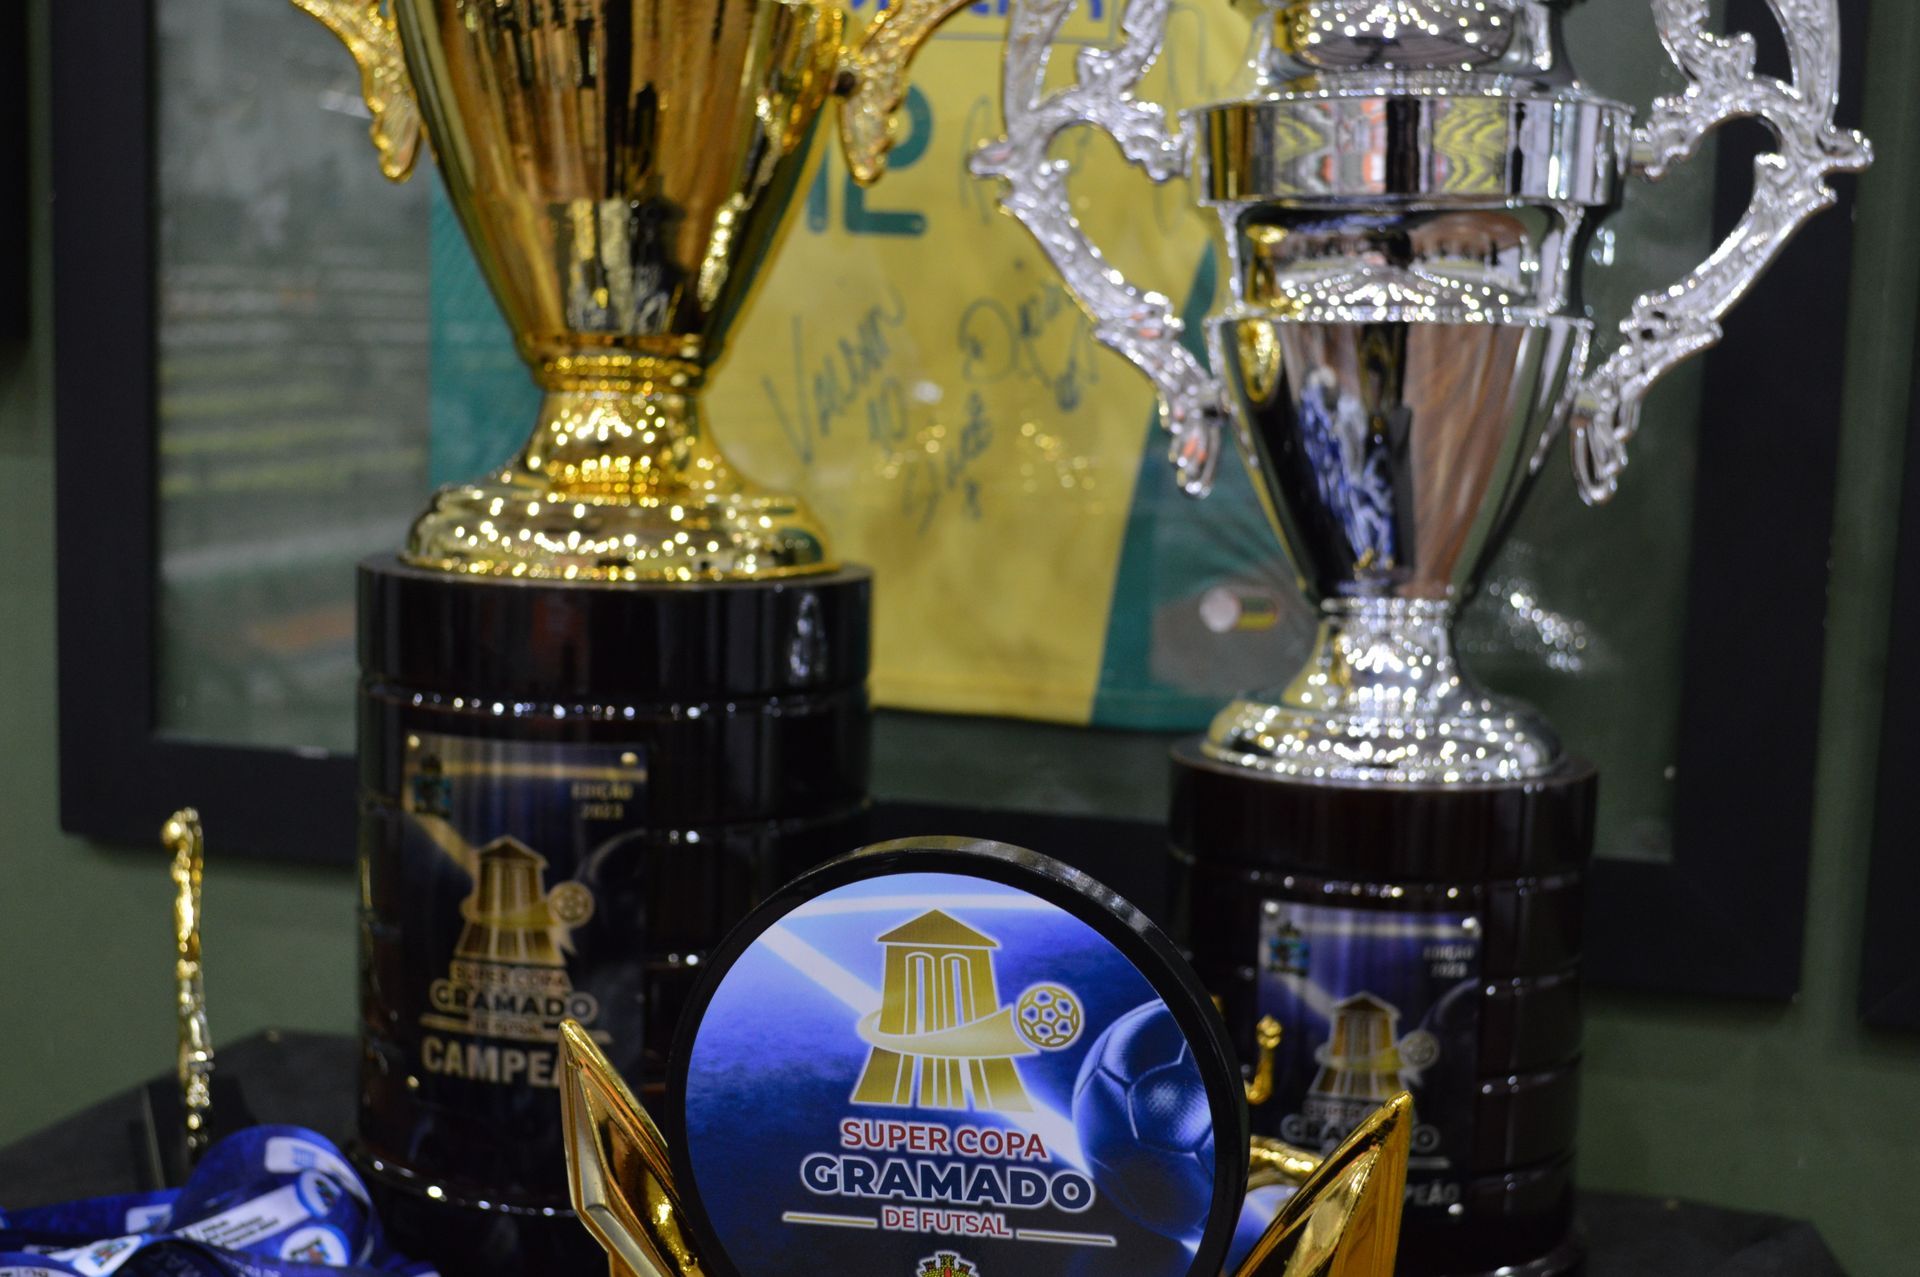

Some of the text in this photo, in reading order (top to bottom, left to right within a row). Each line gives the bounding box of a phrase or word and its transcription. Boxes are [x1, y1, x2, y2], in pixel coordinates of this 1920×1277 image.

[432, 982, 594, 1019] GRAMADO
[842, 1120, 1048, 1160] SUPER COPA
[801, 1154, 1094, 1212] GRAMADO
[884, 1208, 1010, 1237] DE FUTSAL
